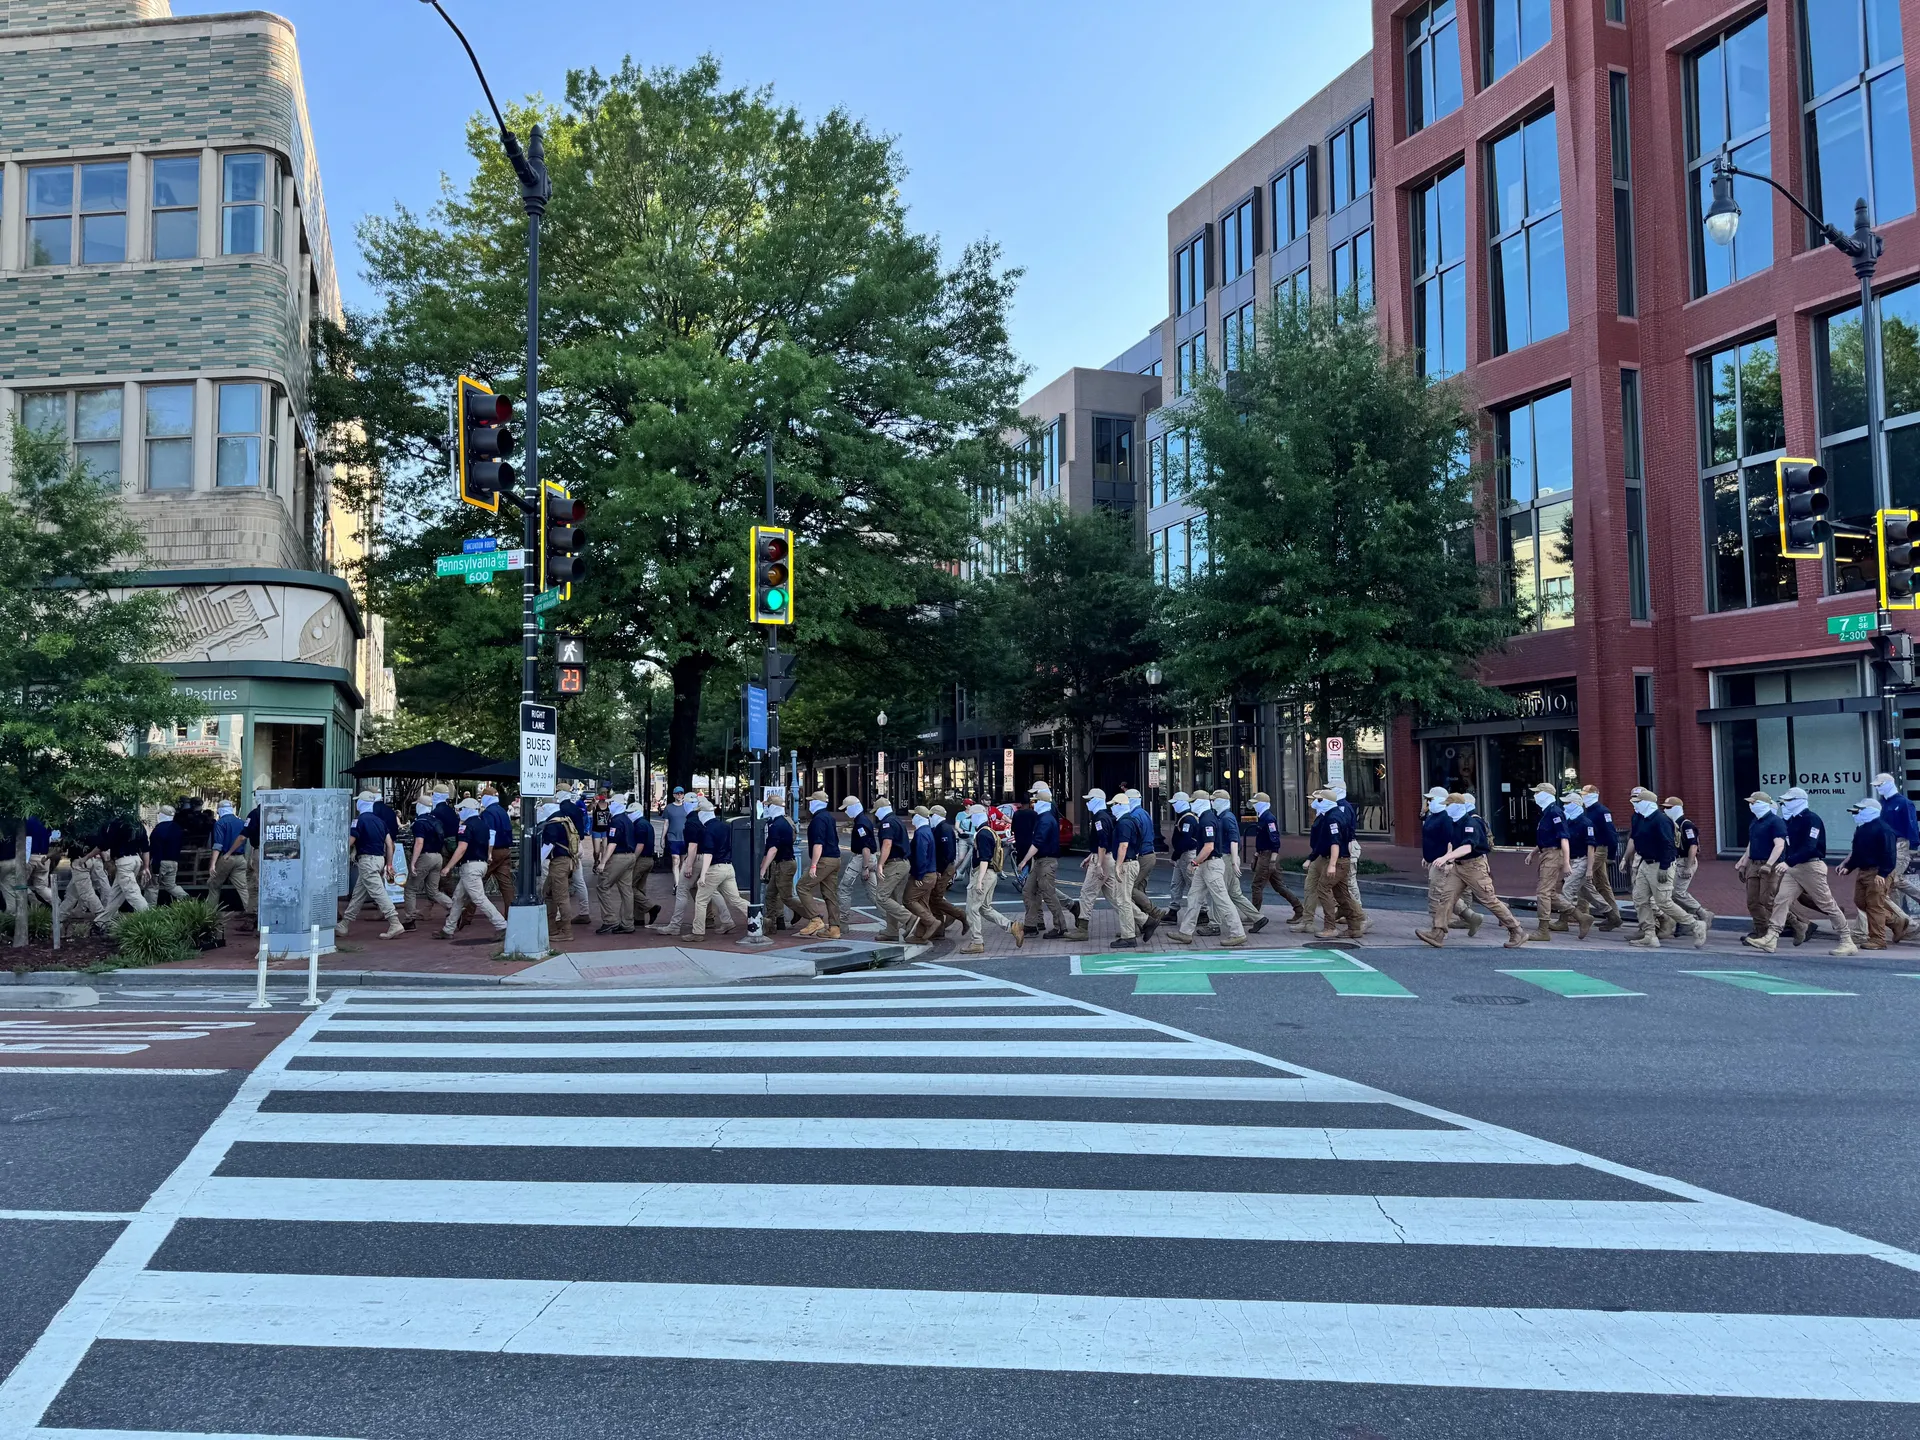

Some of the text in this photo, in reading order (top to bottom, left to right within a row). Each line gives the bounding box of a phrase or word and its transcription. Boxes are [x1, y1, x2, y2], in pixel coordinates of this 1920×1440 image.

[437, 557, 496, 573] Pennsylvania
[469, 571, 489, 581] 600
[1839, 618, 1850, 631] 7
[1840, 631, 1867, 641] 2-300
[561, 669, 580, 691] 23
[185, 685, 238, 701] Pastries
[531, 709, 546, 719] RIGHT
[532, 721, 545, 730] LANE
[526, 737, 551, 752] BUSES
[528, 754, 549, 767] ONLY
[1762, 772, 1829, 785] SEPORA
[266, 824, 298, 833] MERCY
[275, 832, 297, 840] HERE
